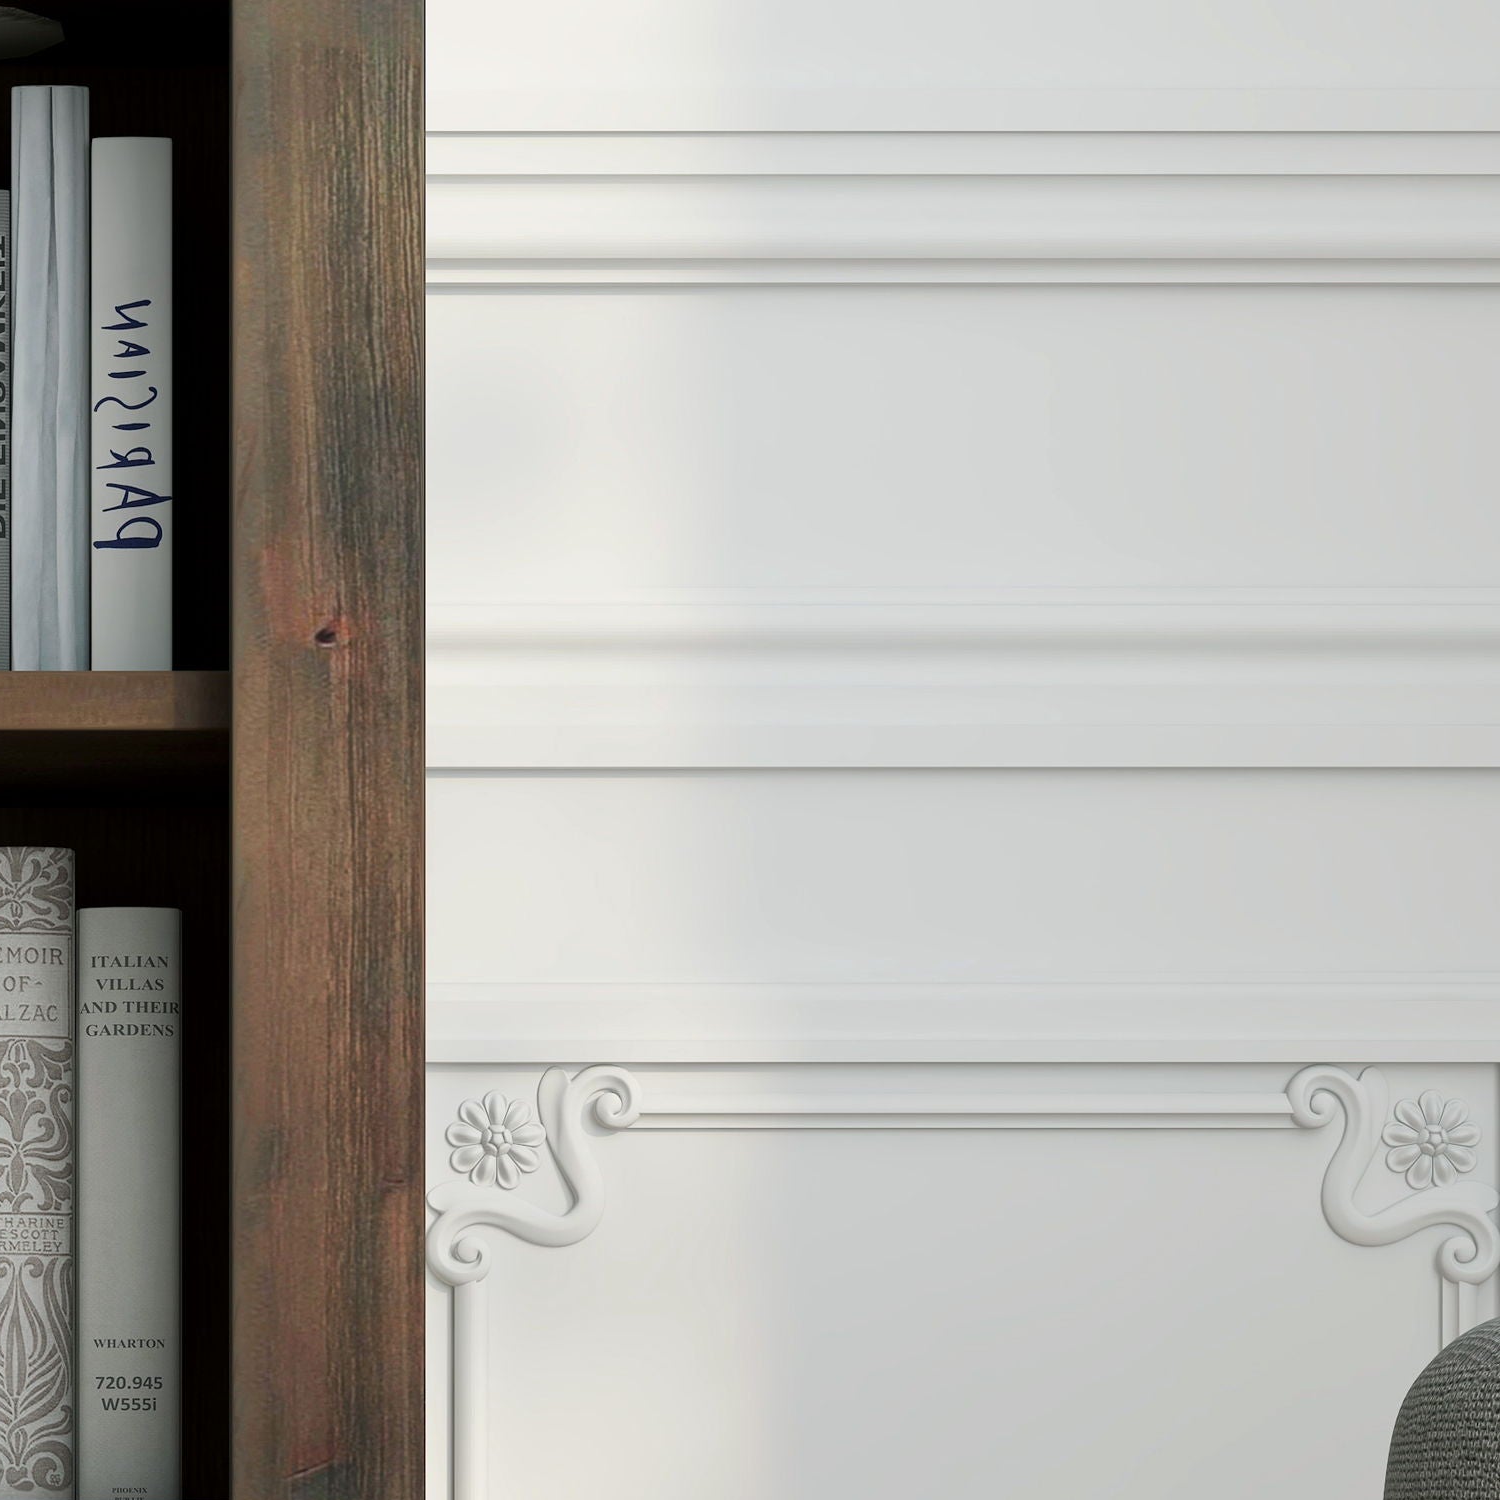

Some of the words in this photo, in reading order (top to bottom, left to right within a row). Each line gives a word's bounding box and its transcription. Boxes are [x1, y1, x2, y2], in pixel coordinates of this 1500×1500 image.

[91, 955, 169, 968] ITALIAN
[3, 975, 31, 993] OF
[96, 978, 164, 991] VILLAS
[79, 1001, 117, 1014] AND
[122, 1001, 180, 1014] THEIR
[85, 1024, 174, 1037] GARDENS
[94, 1339, 165, 1349] WHARTON
[95, 1376, 163, 1390] 720.945
[102, 1397, 157, 1411] W555i
